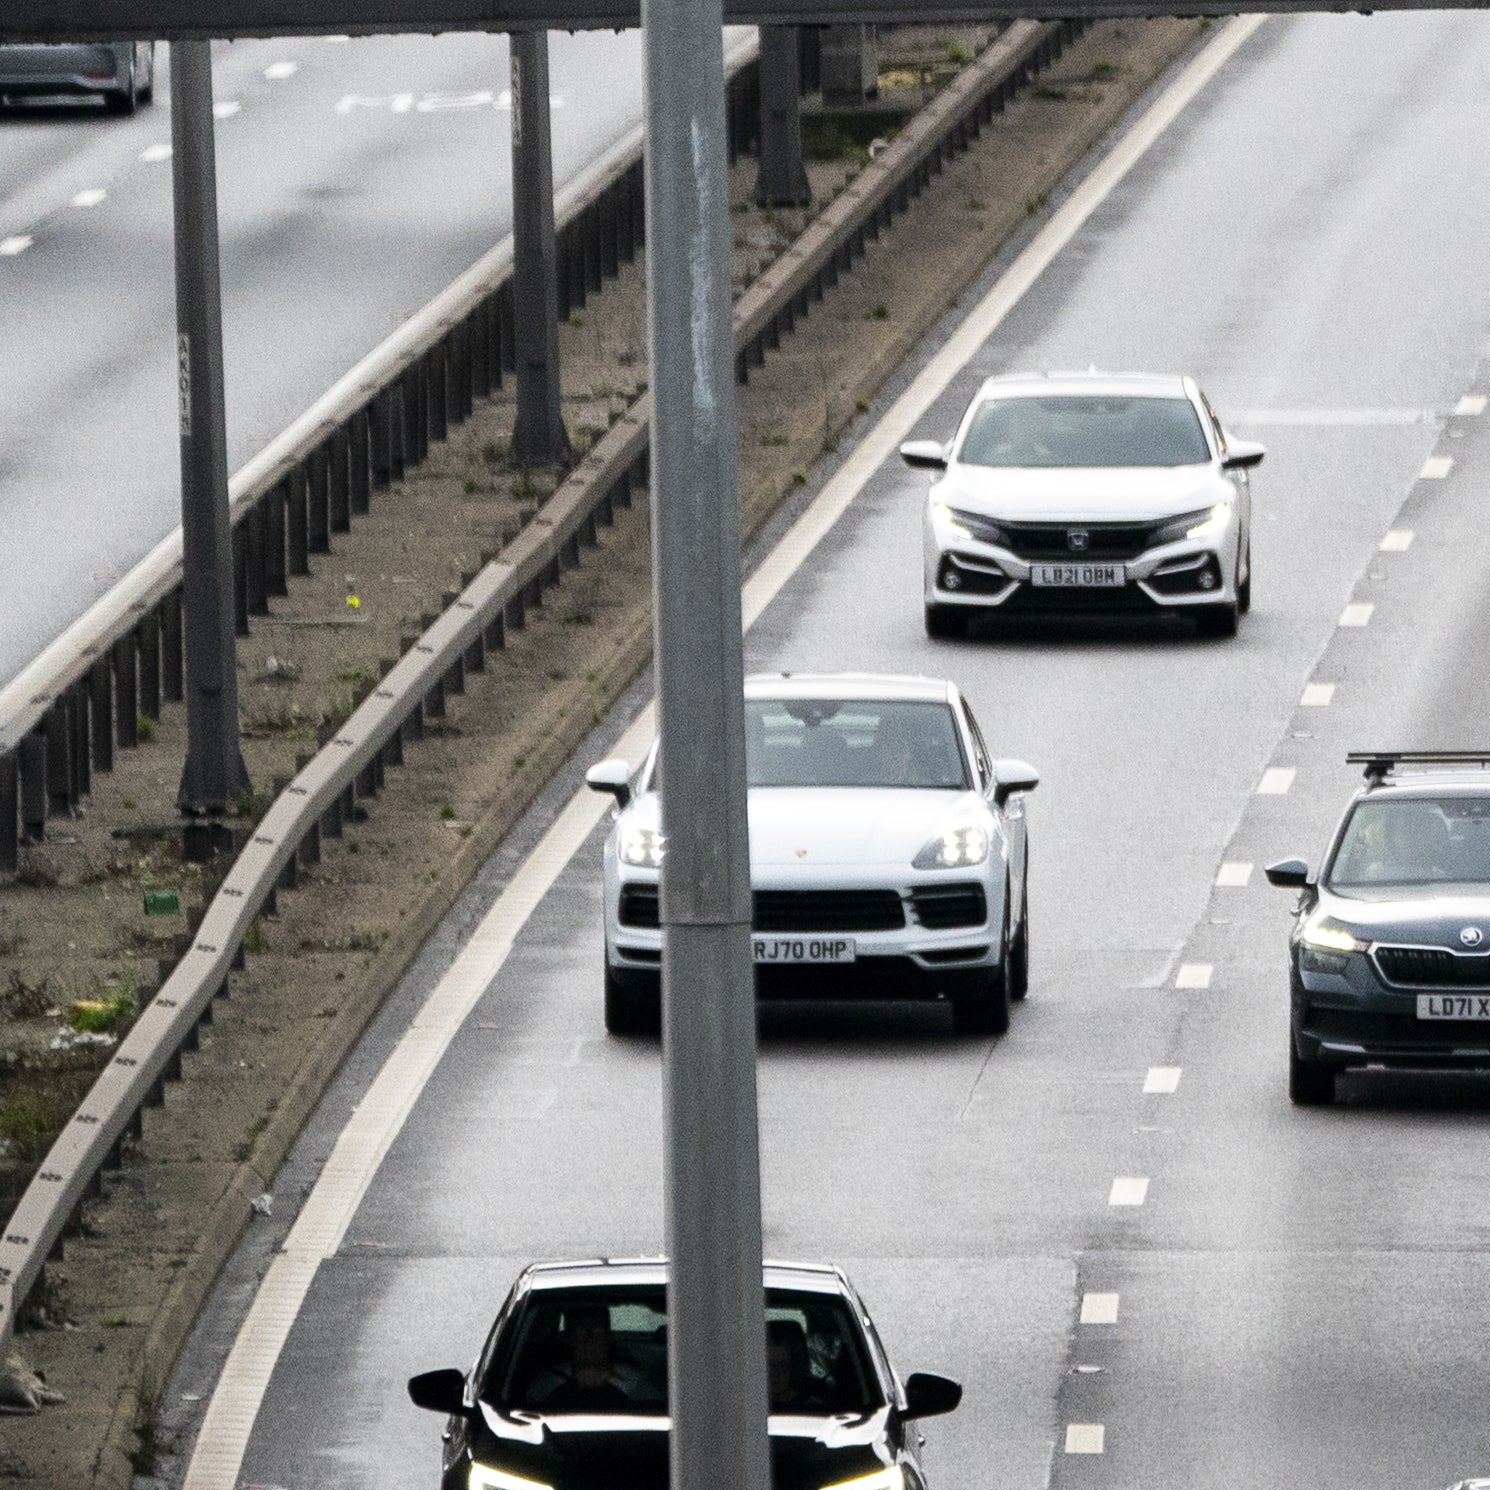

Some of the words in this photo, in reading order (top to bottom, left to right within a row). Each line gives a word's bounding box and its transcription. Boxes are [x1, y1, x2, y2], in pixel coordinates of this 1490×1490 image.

[755, 943, 803, 960] RJ70
[810, 943, 846, 960] OHP
[1428, 999, 1472, 1017] LD71
